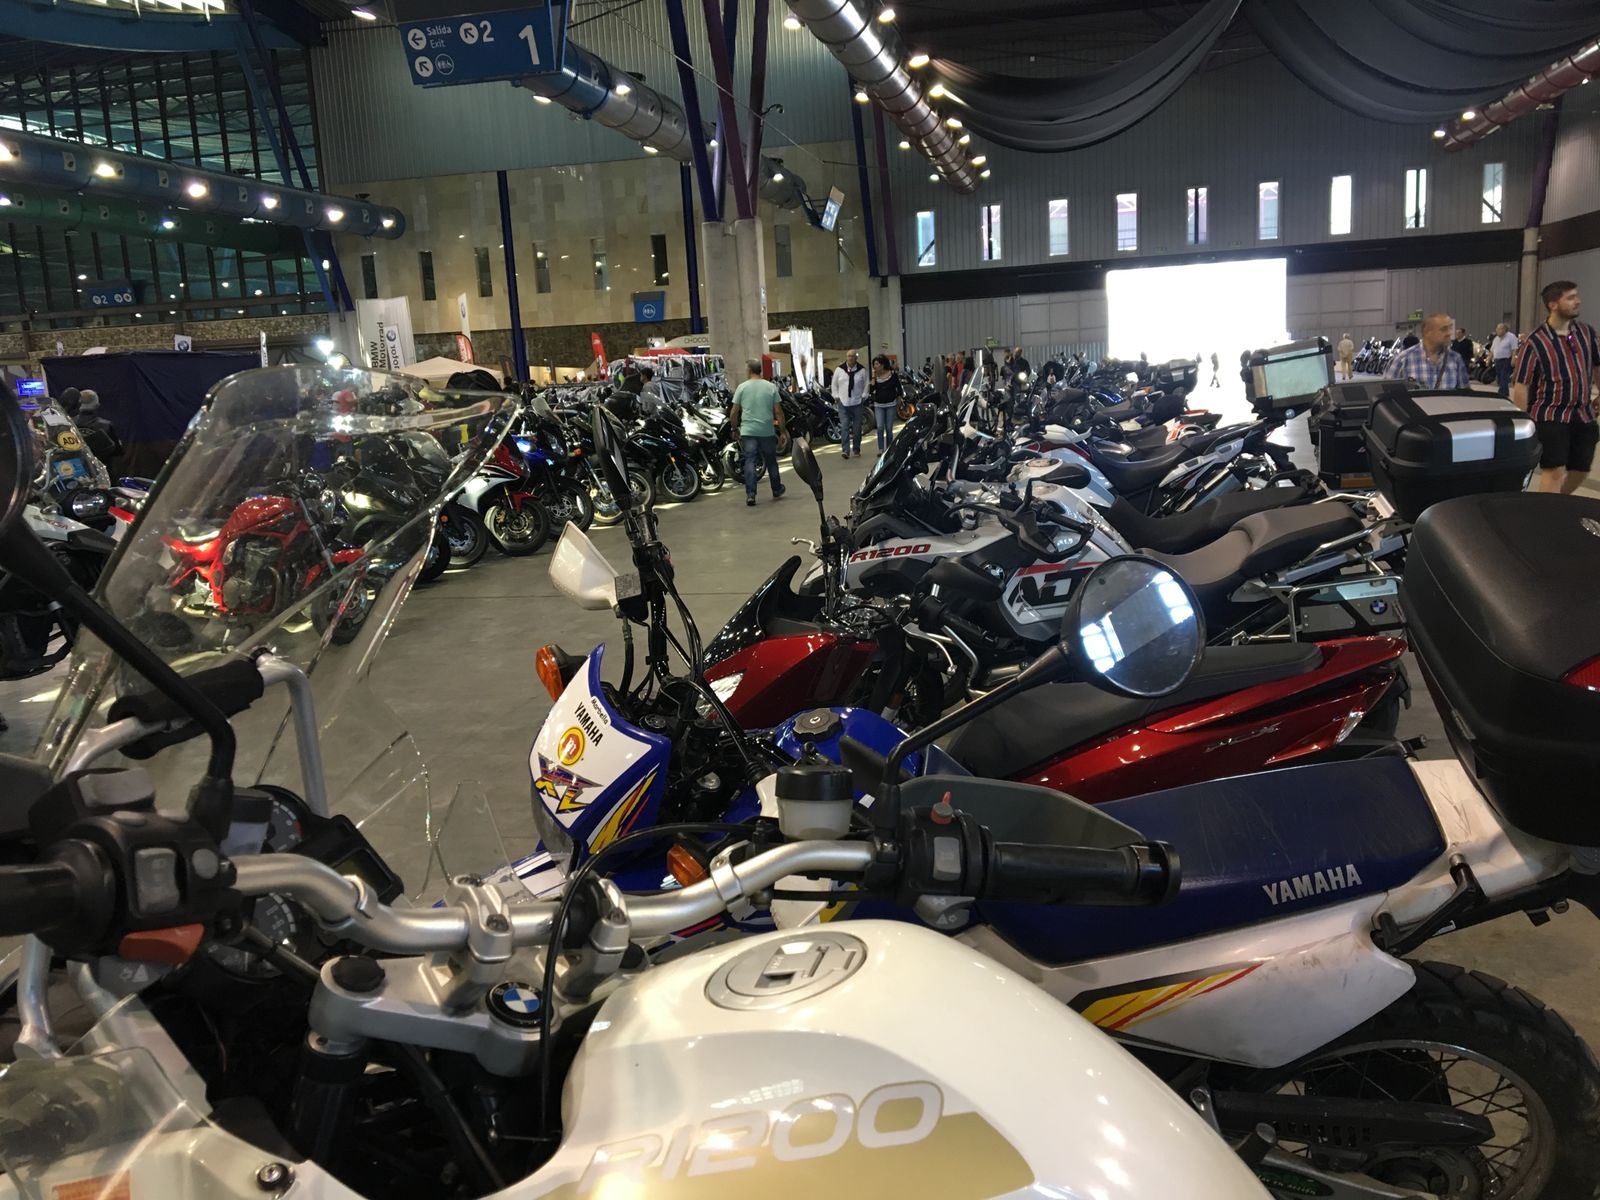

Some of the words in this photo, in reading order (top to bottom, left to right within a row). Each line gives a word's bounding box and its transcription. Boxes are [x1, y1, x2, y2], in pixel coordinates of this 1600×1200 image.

[426, 25, 452, 36] Salida
[479, 20, 494, 42] 2
[430, 39, 446, 49] Exit
[518, 24, 540, 65] 1
[371, 342, 379, 368] BMW
[377, 322, 386, 368] Motorrad
[850, 543, 931, 562] R1200
[574, 701, 604, 747] YAMAHA
[591, 699, 609, 725] Marbella
[1262, 863, 1362, 905] YAMAHA
[576, 1080, 944, 1195] R1200
